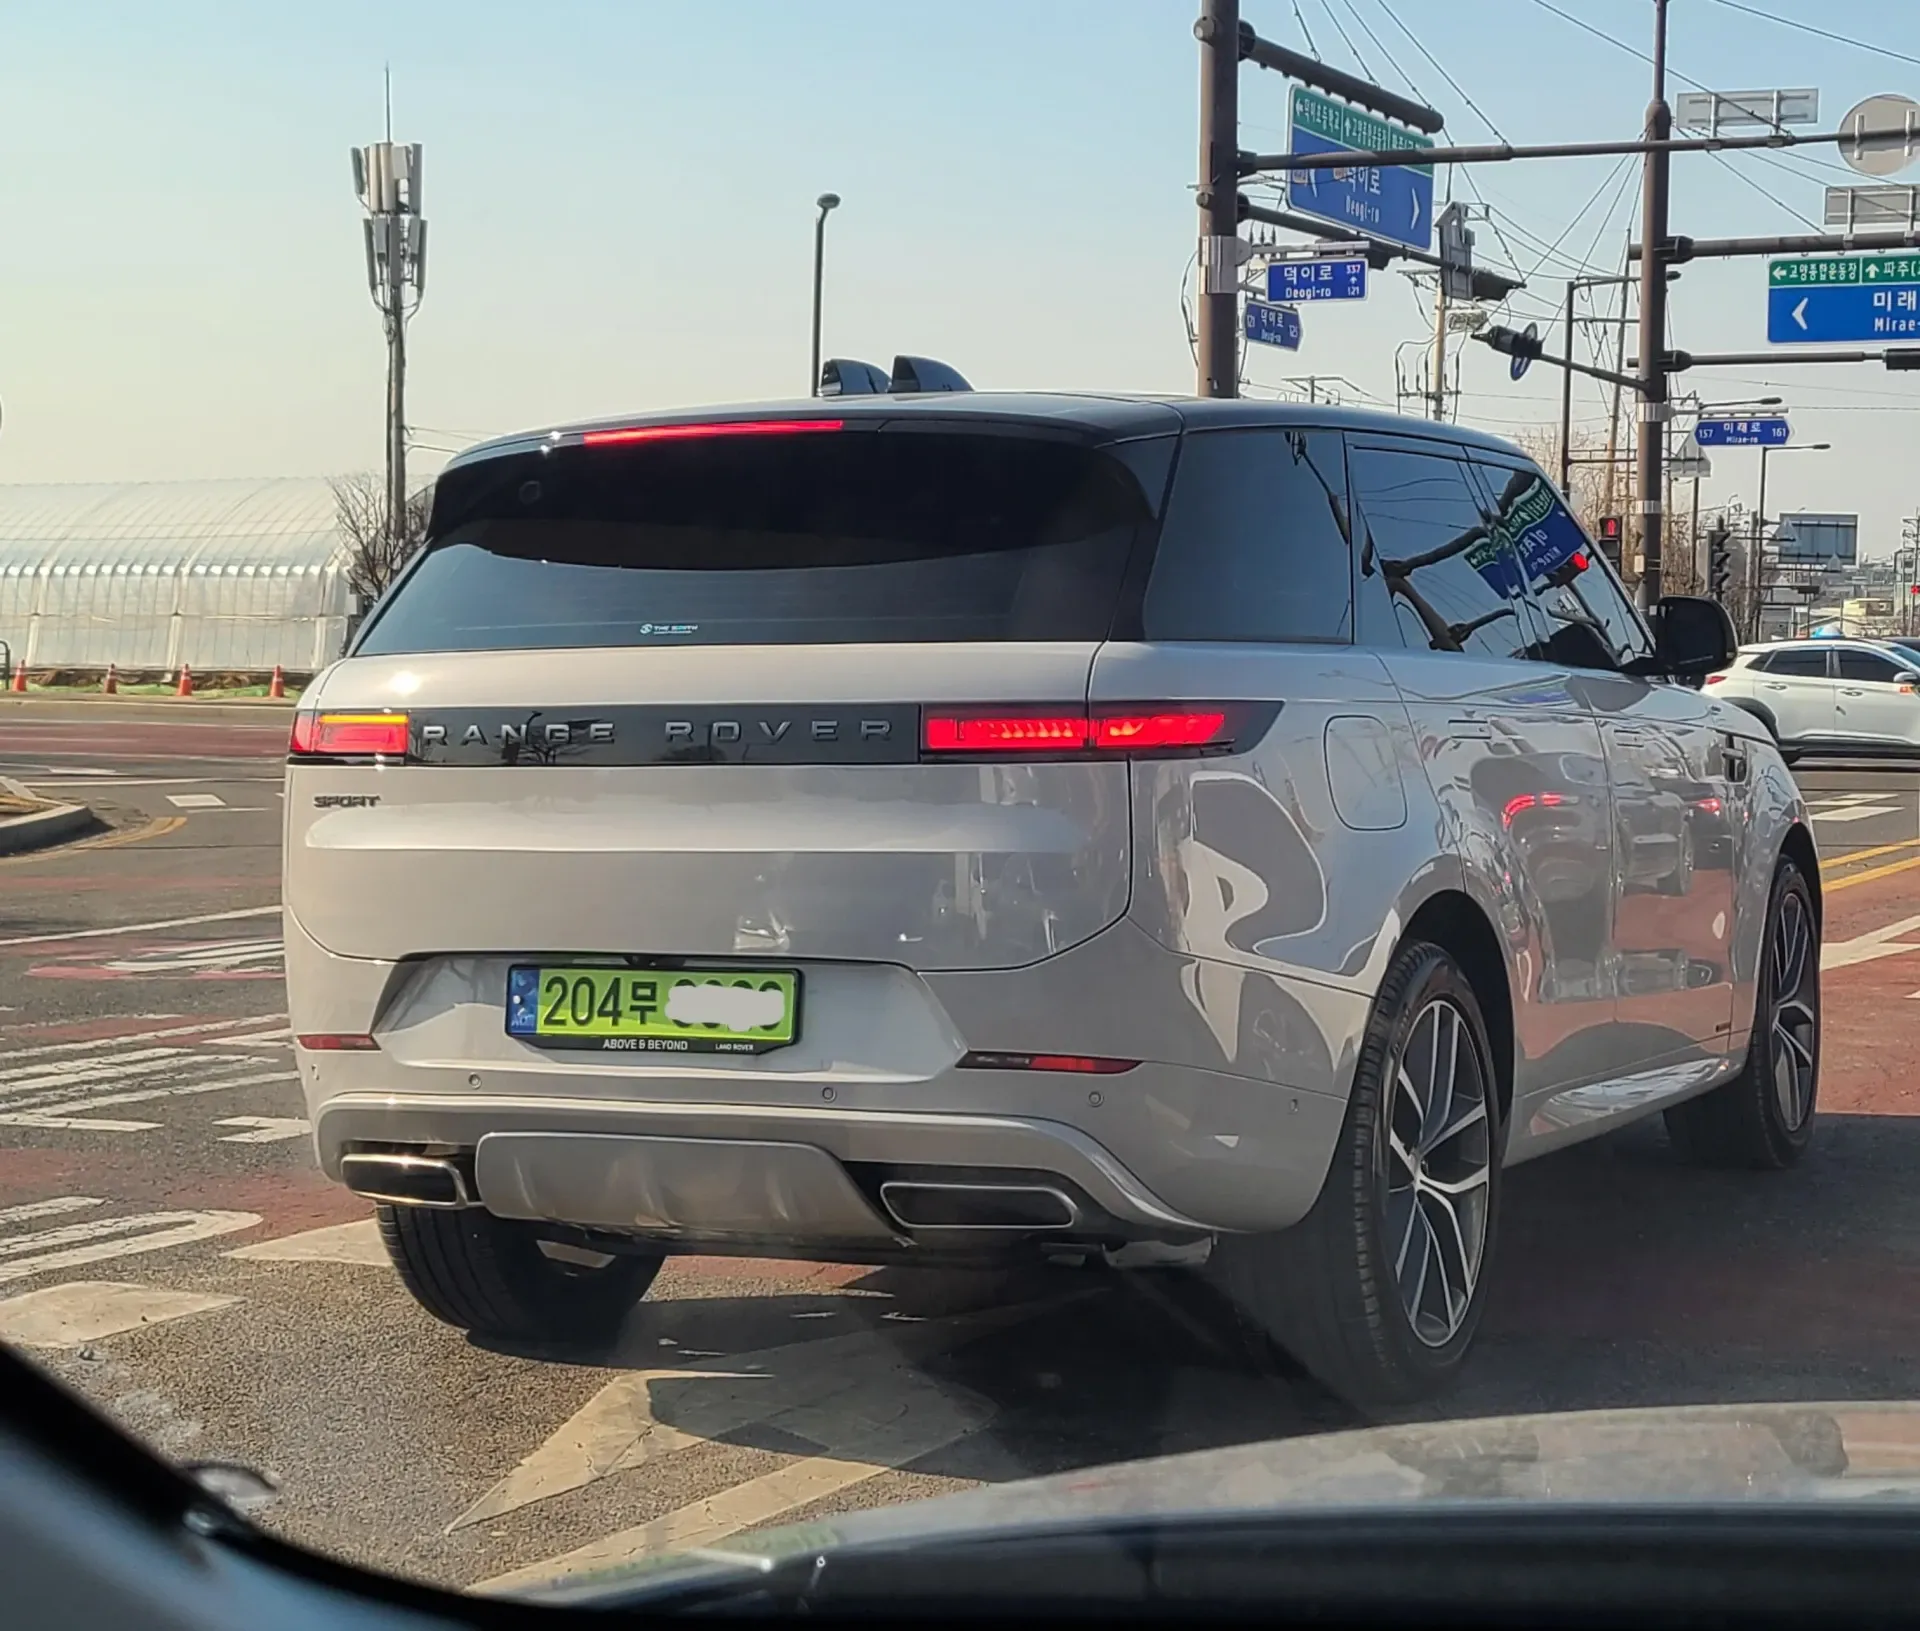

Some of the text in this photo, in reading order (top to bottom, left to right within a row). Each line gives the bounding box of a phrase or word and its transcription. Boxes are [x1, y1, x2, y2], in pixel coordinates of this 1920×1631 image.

[1284, 265, 1333, 285] 덕이로
[1789, 262, 1857, 281] 고양종합운동장
[1285, 286, 1332, 299] Deogi-ro
[1873, 290, 1917, 312] 미래
[1699, 429, 1714, 439] 157
[1723, 422, 1762, 434] 미래로
[1771, 428, 1787, 437] 161
[422, 720, 892, 746] RANGE ROVER
[313, 795, 381, 808] SPORT
[543, 976, 658, 1028] 204무
[603, 1039, 637, 1049] ABOVE
[648, 1039, 688, 1050] BEYOND
[733, 1043, 754, 1051] ROVER
